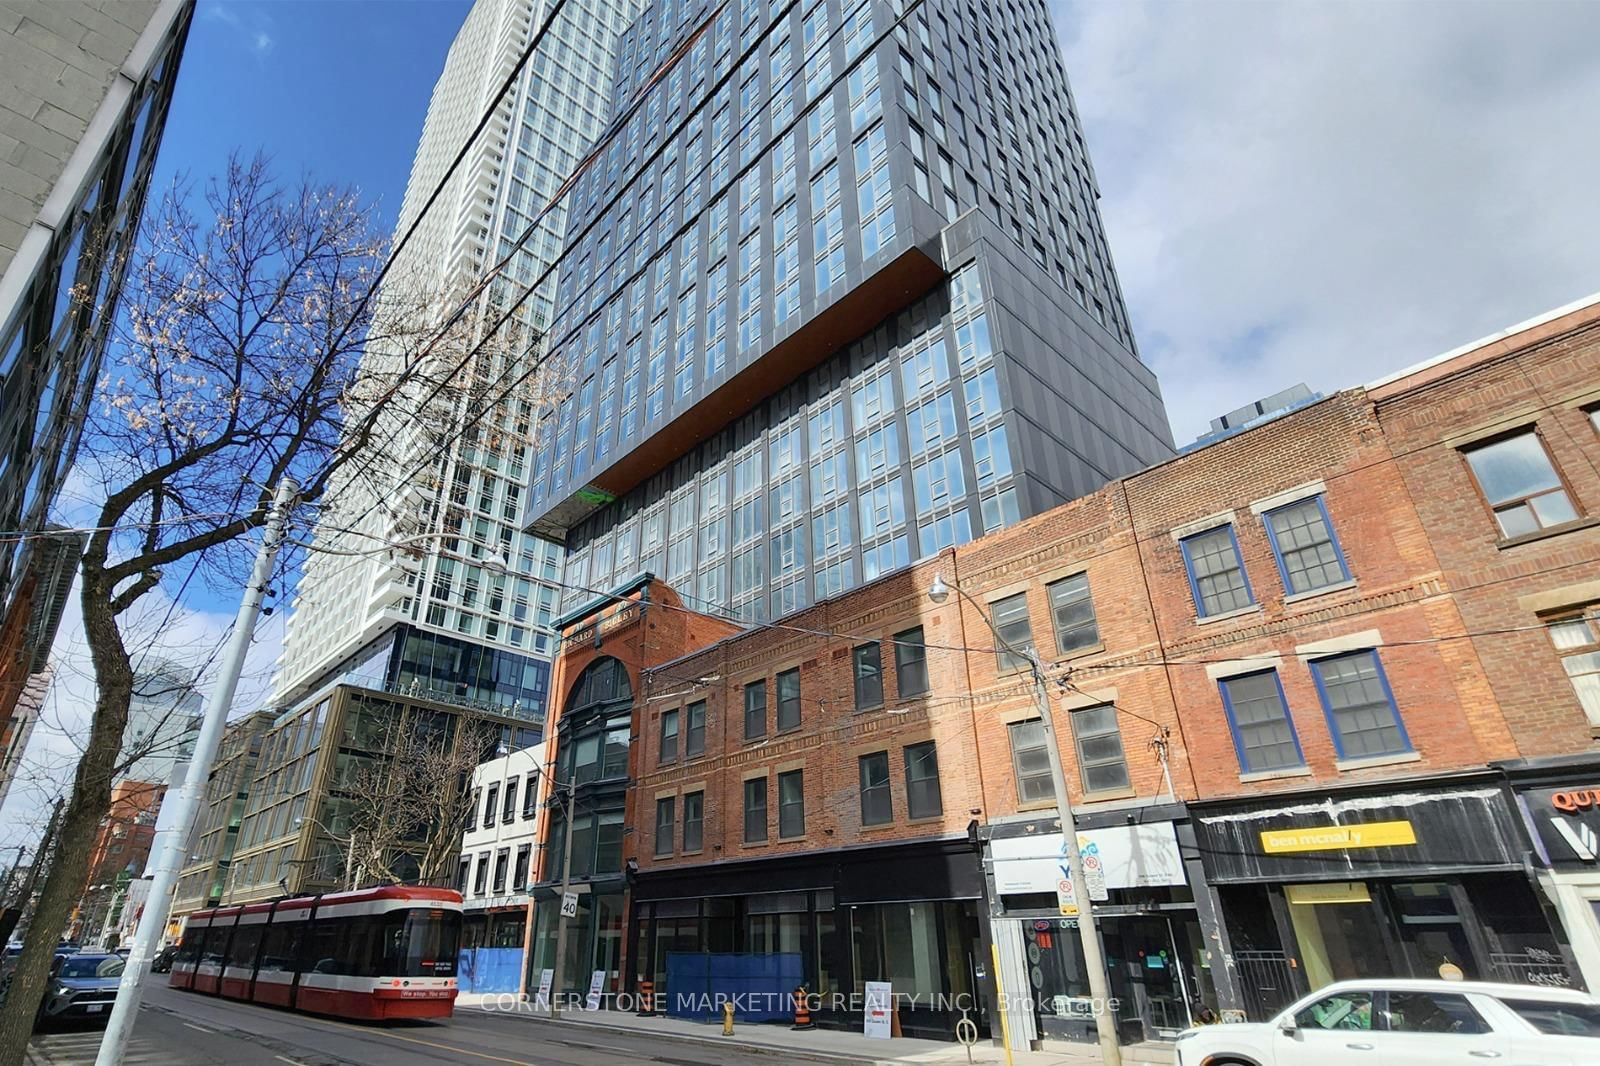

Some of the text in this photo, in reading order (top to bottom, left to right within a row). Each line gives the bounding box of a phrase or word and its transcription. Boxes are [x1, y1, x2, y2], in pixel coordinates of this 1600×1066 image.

[1268, 834, 1297, 848] ben
[563, 902, 576, 914] 40
[1060, 919, 1080, 929] OPE
